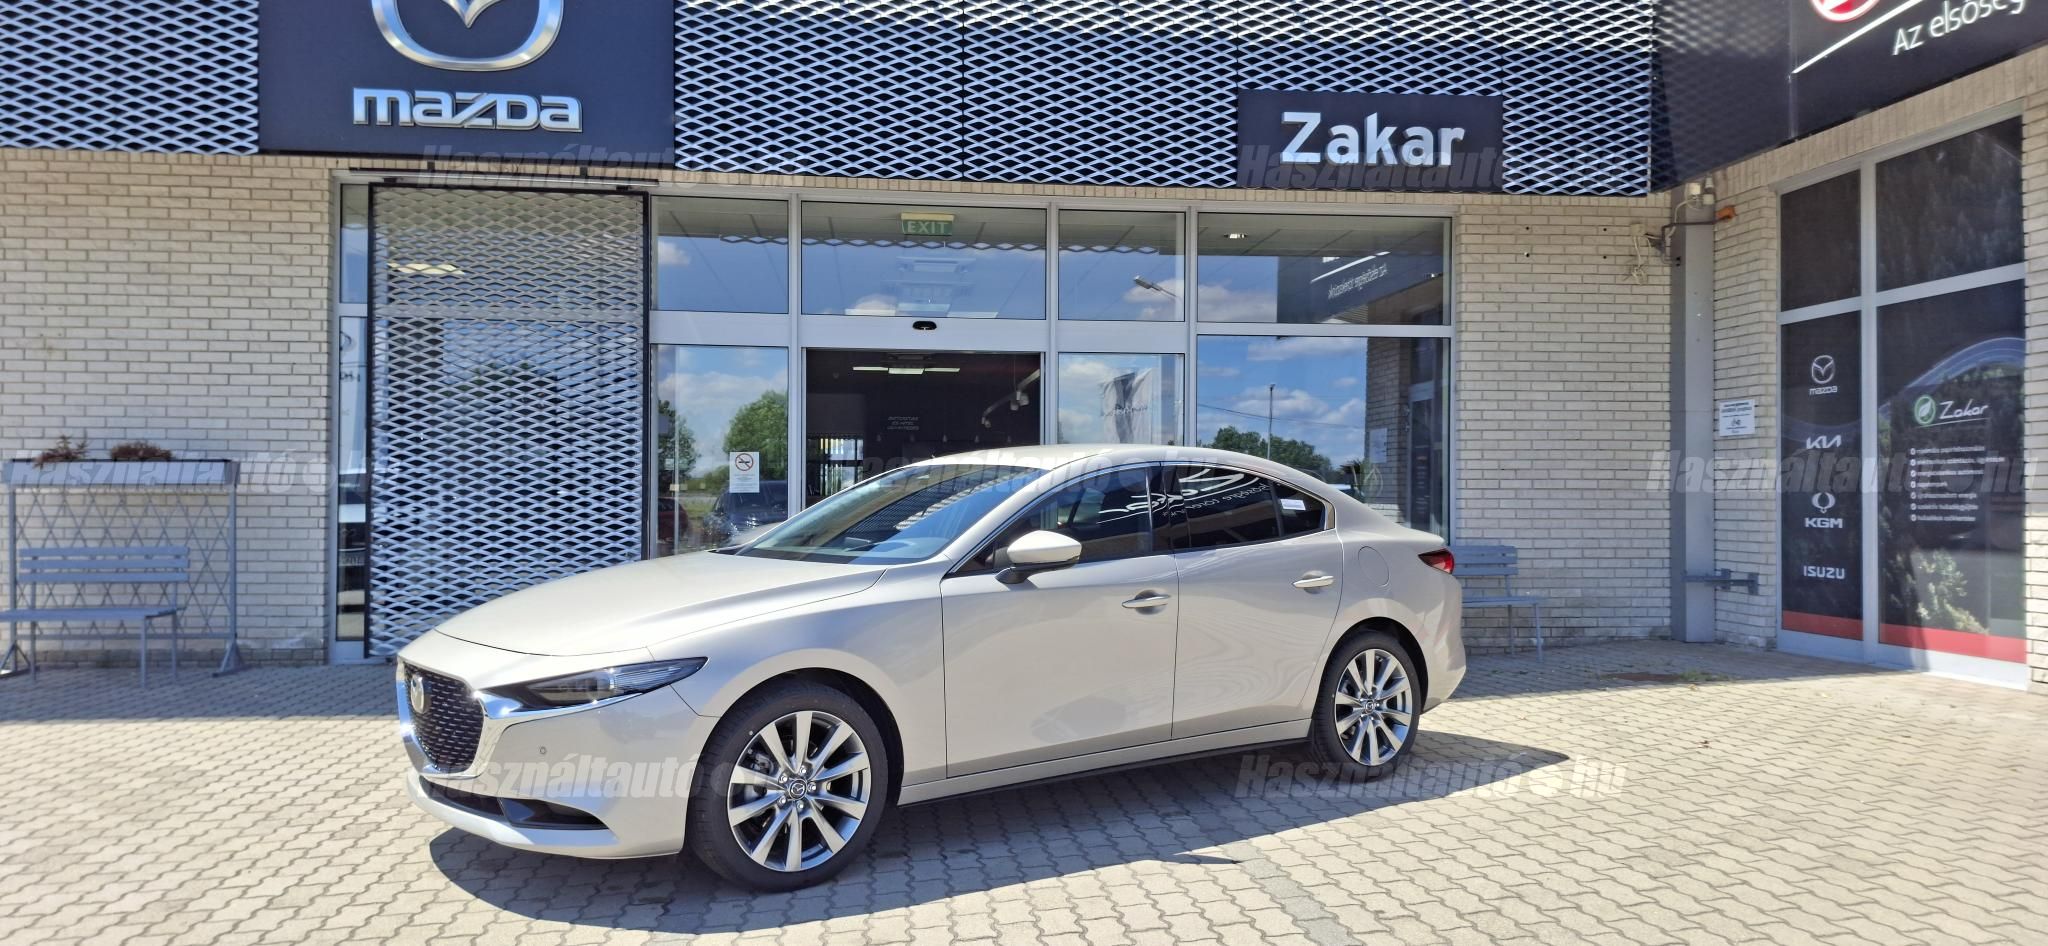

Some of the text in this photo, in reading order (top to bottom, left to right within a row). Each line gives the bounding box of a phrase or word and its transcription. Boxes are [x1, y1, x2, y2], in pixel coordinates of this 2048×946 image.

[1892, 24, 1925, 56] Az
[1279, 111, 1466, 167] Zakar
[907, 220, 950, 234] EXIT
[1938, 398, 1990, 420] Zakar
[1806, 434, 1842, 450] KIA
[1804, 517, 1844, 529] KGM
[1803, 565, 1846, 580] ISUZU
